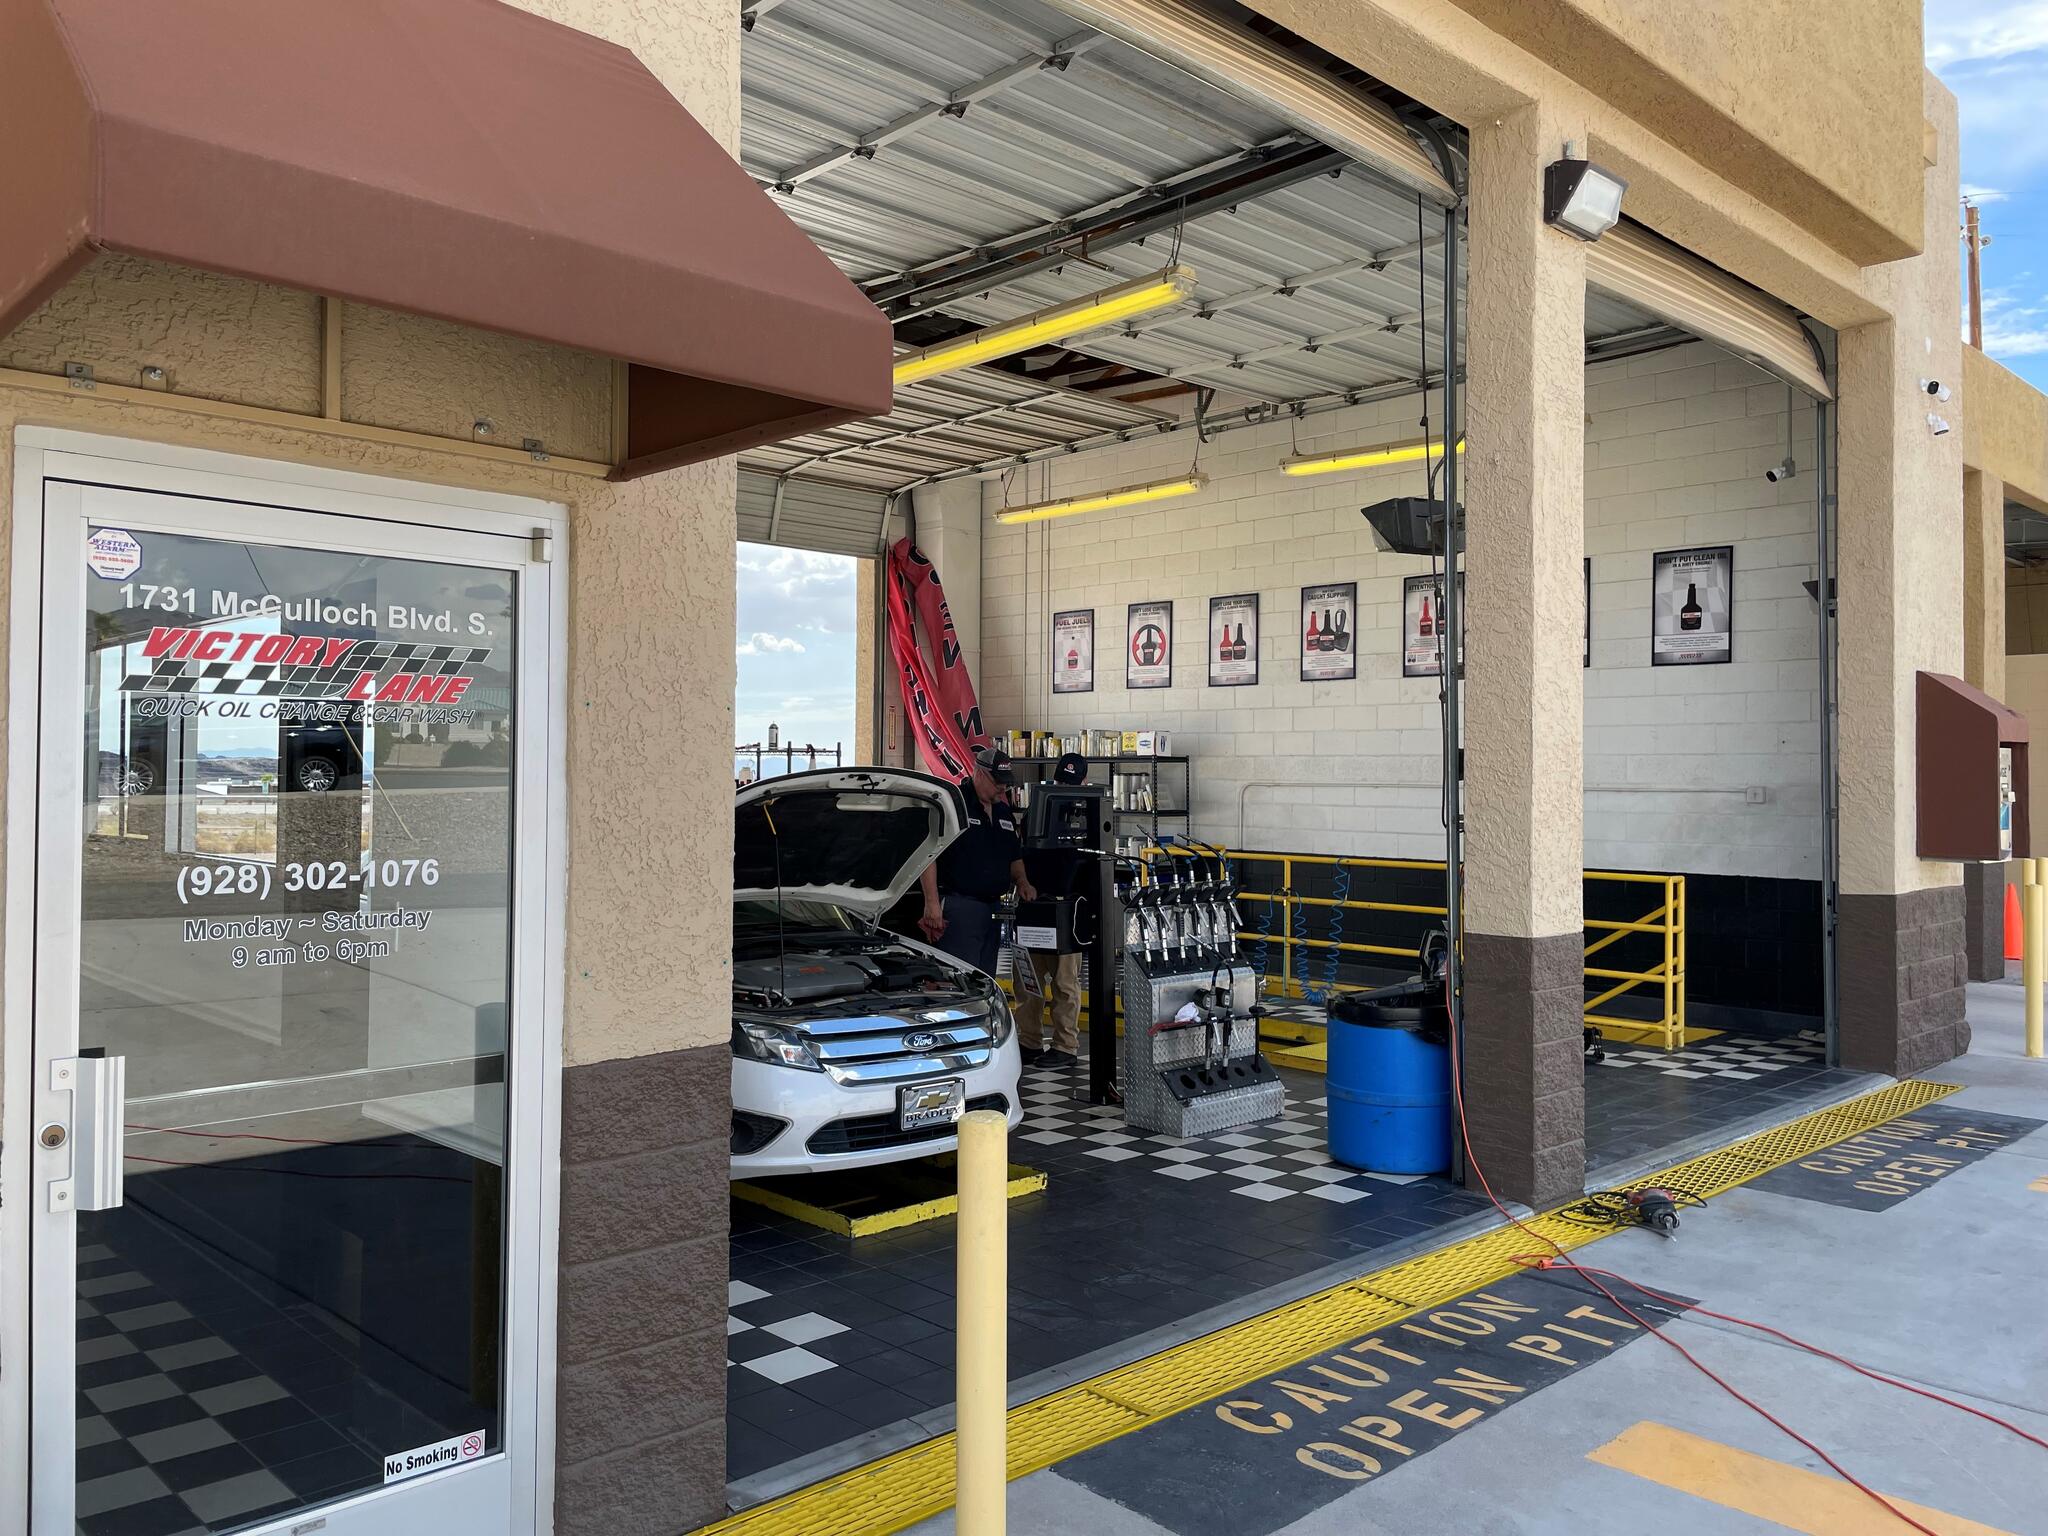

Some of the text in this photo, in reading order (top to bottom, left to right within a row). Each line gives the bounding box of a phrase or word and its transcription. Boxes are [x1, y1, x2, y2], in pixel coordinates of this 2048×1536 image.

[92, 538, 137, 548] WESTERN
[94, 544, 126, 552] ALARM
[1658, 556, 1677, 565] DON'T
[1679, 555, 1693, 563] PUT
[1694, 553, 1717, 562] CLEAN
[119, 583, 493, 636] 1731 McCulloch Blvd. S.
[141, 626, 359, 667] VICTORY
[344, 671, 474, 704] LANE
[138, 698, 476, 725] QUICK OIL CHANGE & CAR WASH
[176, 858, 440, 904] (928) 302-1076
[183, 916, 293, 942] Monday
[322, 907, 433, 932] Saturday
[231, 939, 389, 968] 9 am to 6pm
[913, 1033, 933, 1046] Ford
[905, 1106, 961, 1123] BRADLEY
[1798, 1118, 1941, 1174] CAUTION
[1853, 1127, 2010, 1196] OPEN PIT
[1215, 1292, 1539, 1435] CAUTION
[1295, 1305, 1639, 1481] OPEN PIT
[386, 1446, 458, 1476] No Smoking
